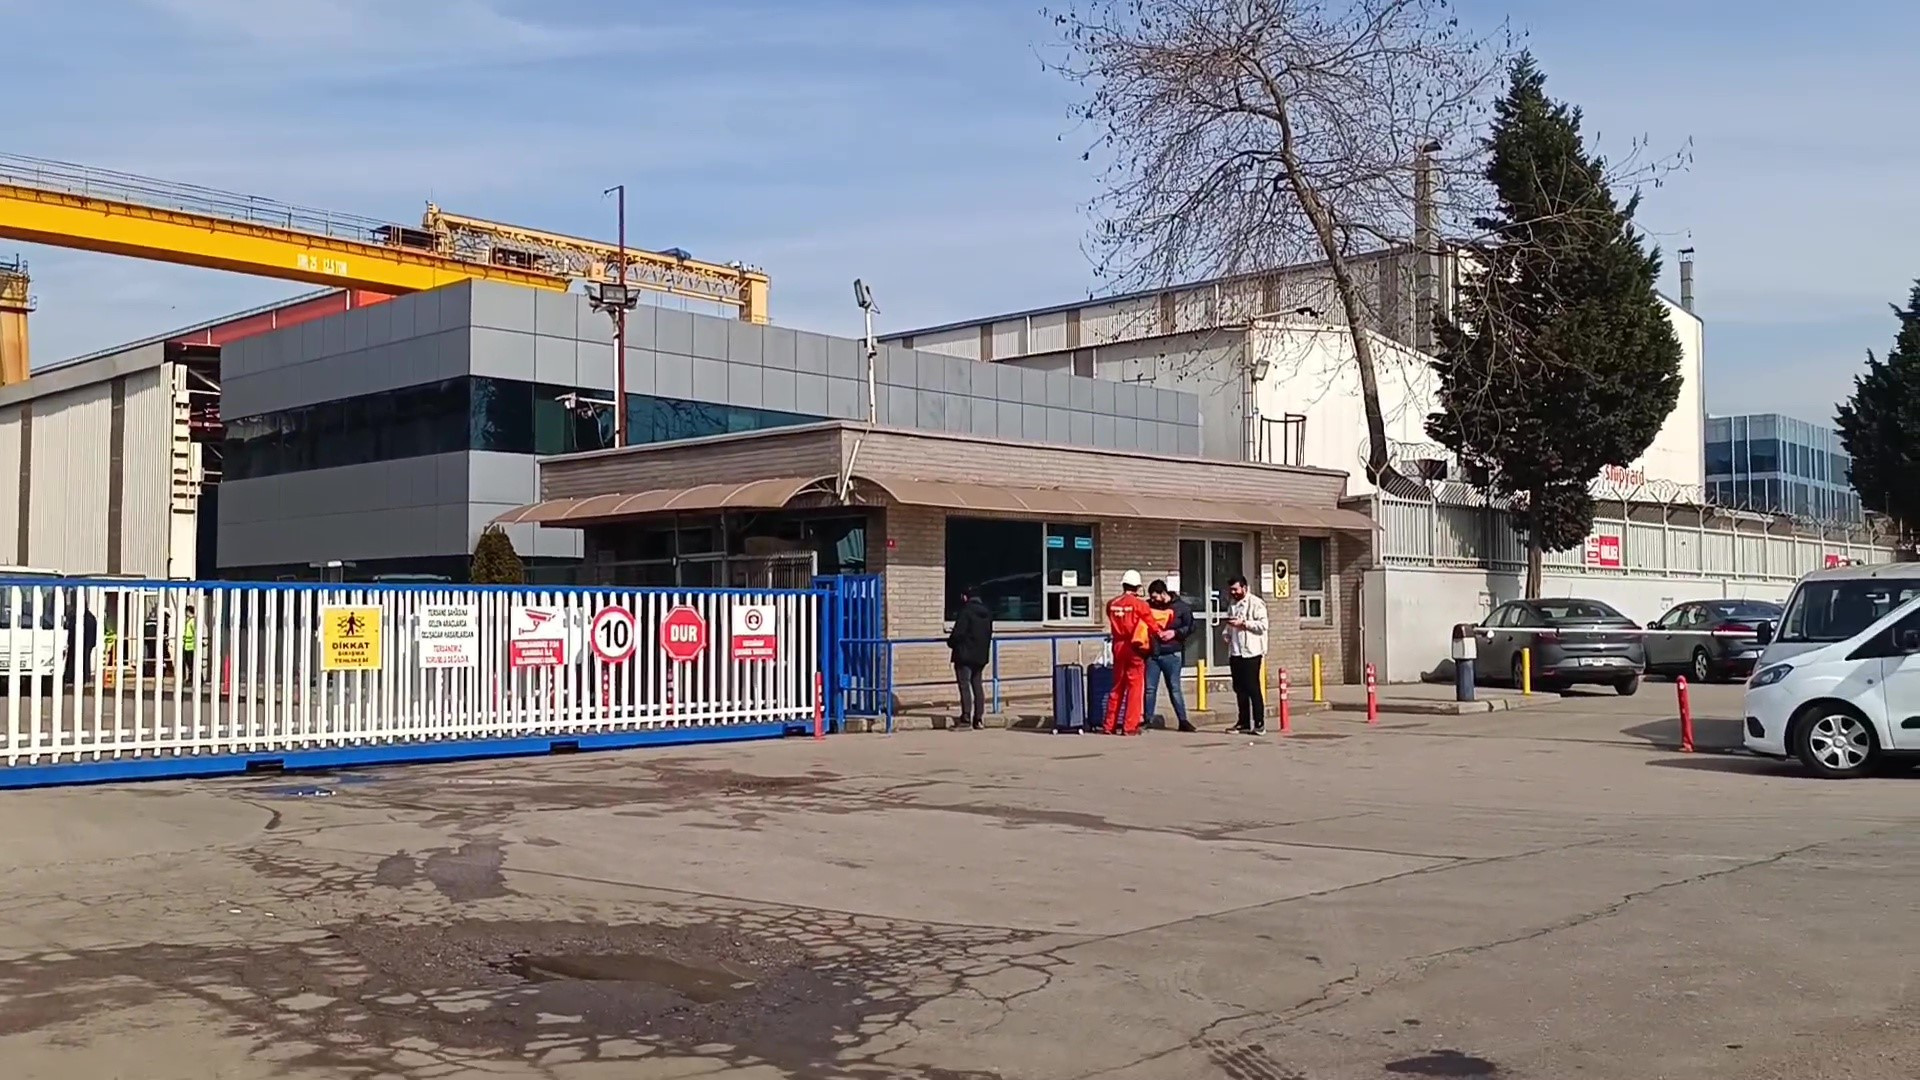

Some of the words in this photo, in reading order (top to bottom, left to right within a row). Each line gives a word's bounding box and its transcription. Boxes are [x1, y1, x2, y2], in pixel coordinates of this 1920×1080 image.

[1605, 465, 1644, 489] shipyard
[600, 619, 629, 648] 10
[670, 623, 698, 643] DUR
[331, 641, 370, 650] DİKKAT
